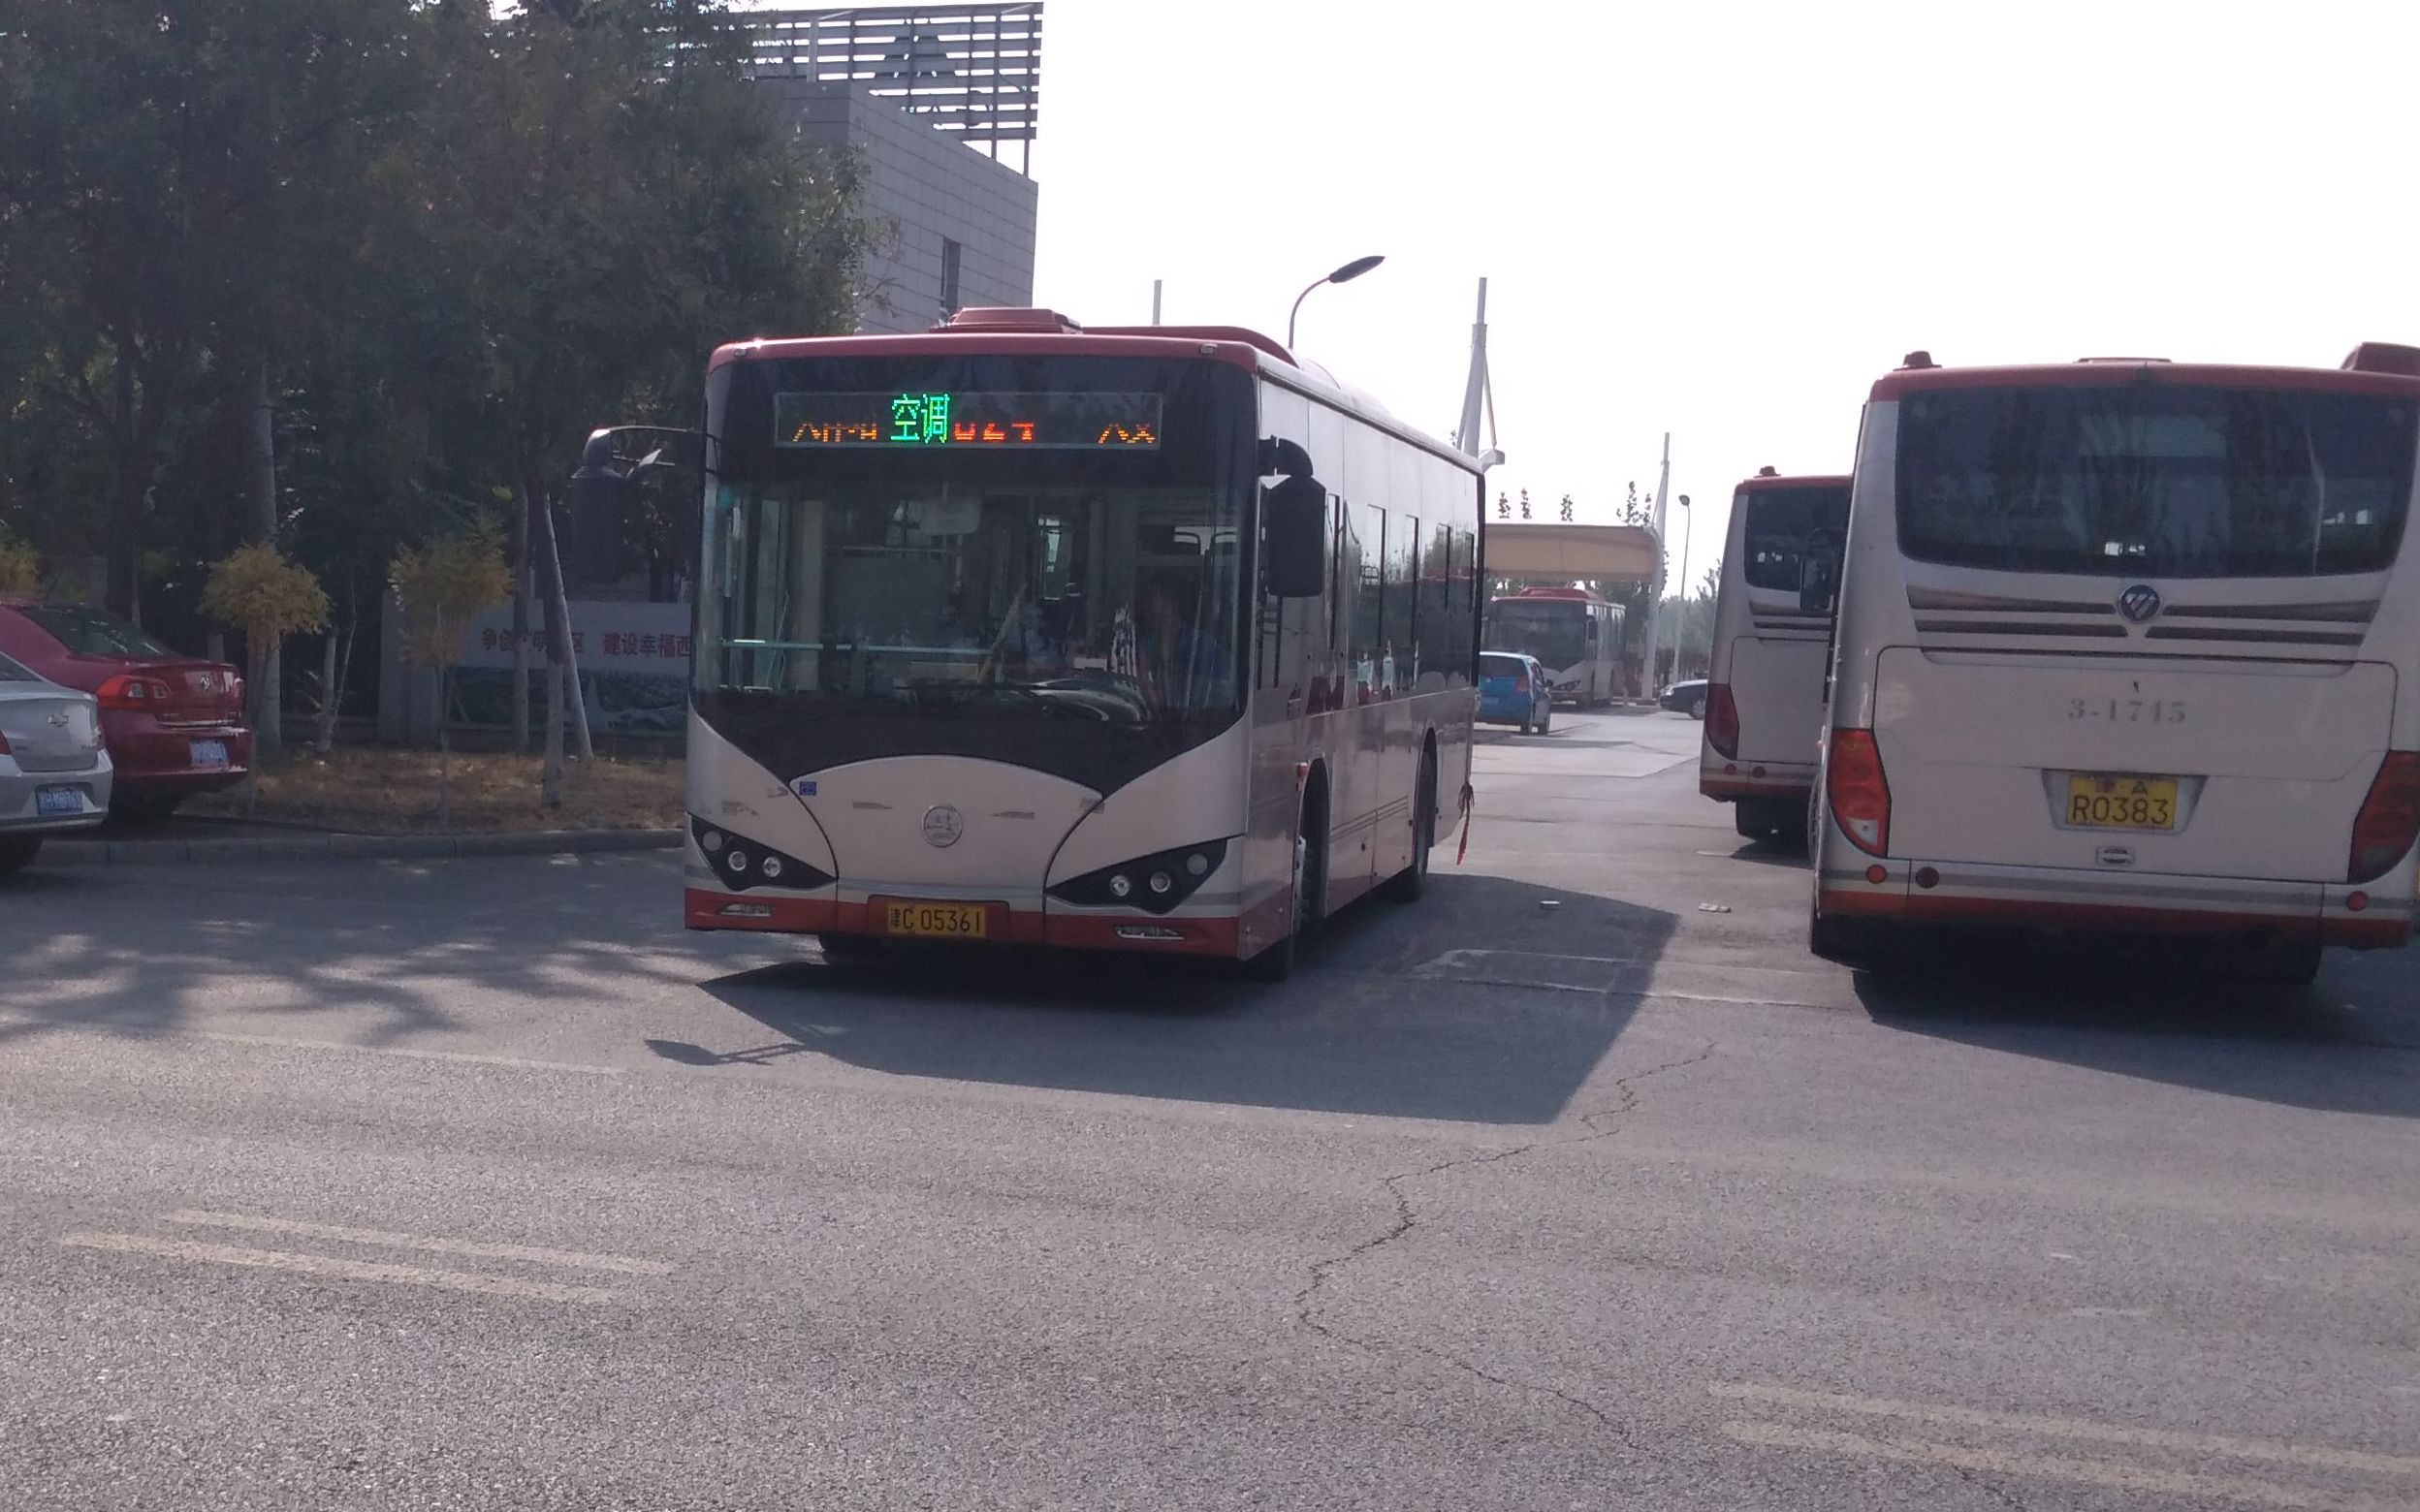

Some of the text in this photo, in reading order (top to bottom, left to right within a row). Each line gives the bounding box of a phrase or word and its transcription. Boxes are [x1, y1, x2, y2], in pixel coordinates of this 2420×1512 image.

[891, 394, 949, 443] 空调
[2068, 699, 2186, 723] 3-1715
[2072, 796, 2169, 825] R0383
